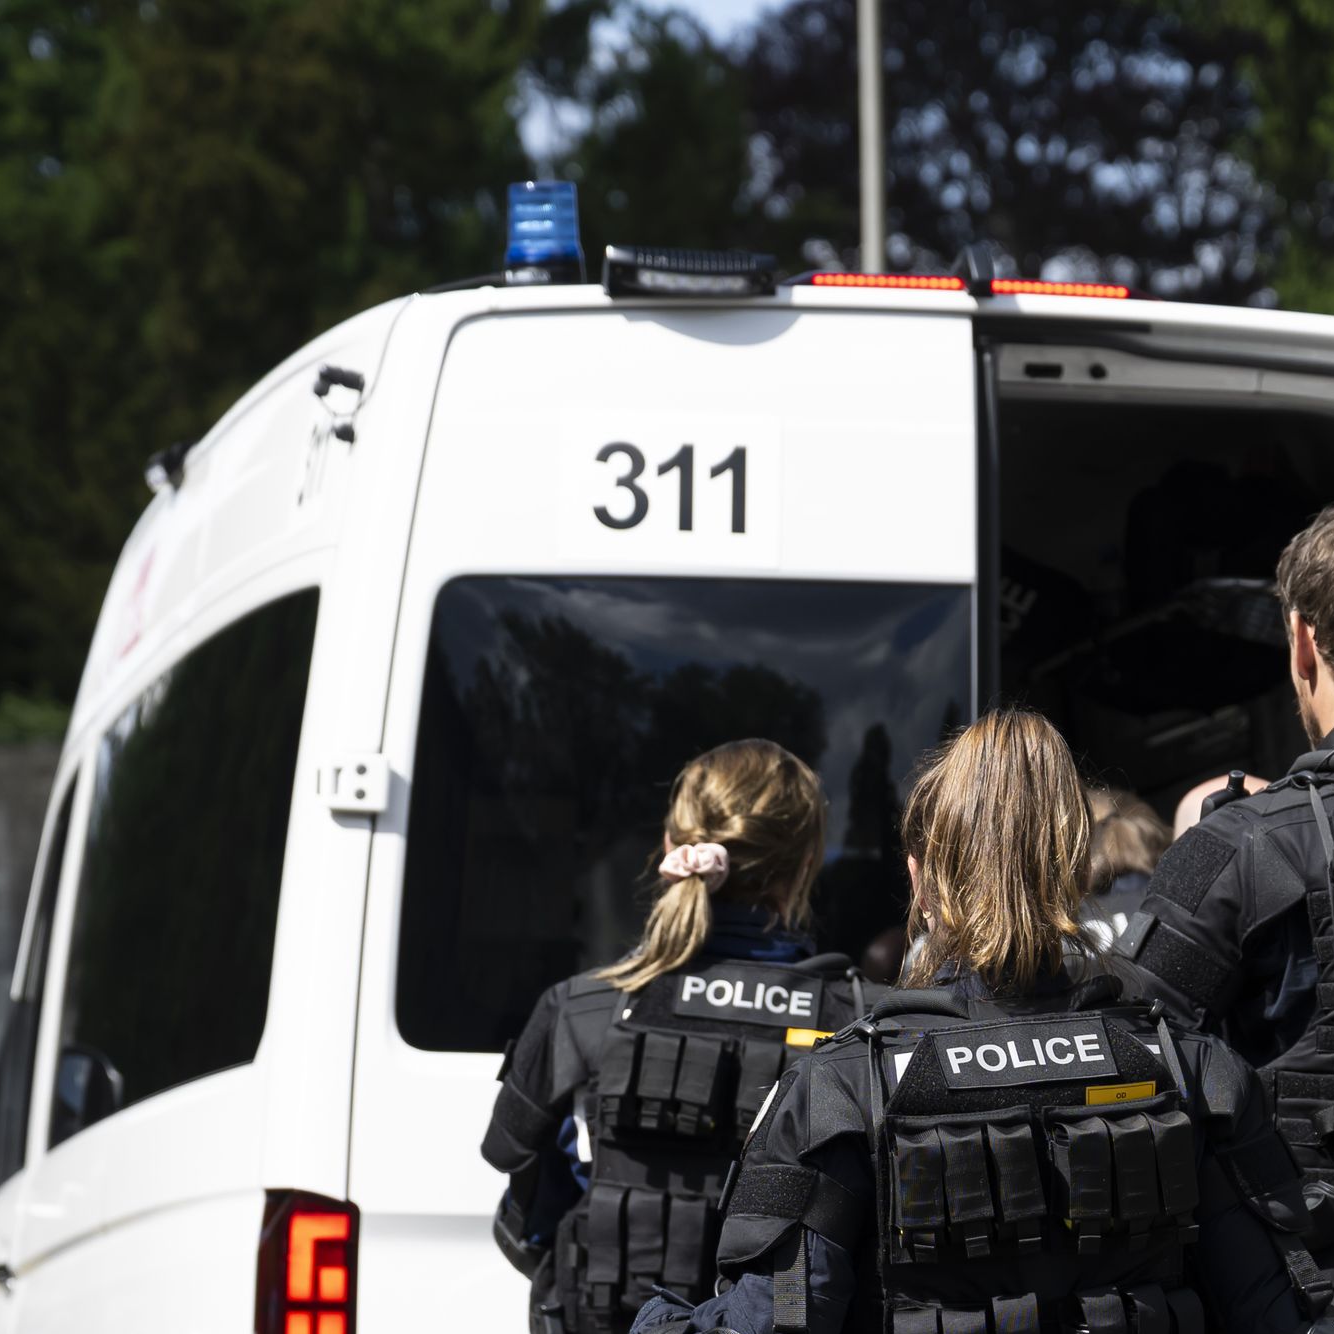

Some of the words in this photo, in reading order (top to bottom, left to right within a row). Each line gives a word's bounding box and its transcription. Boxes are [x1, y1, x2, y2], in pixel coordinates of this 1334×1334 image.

[593, 443, 747, 534] 311
[681, 975, 813, 1017] POLICE
[945, 1033, 1105, 1075] POLICE
